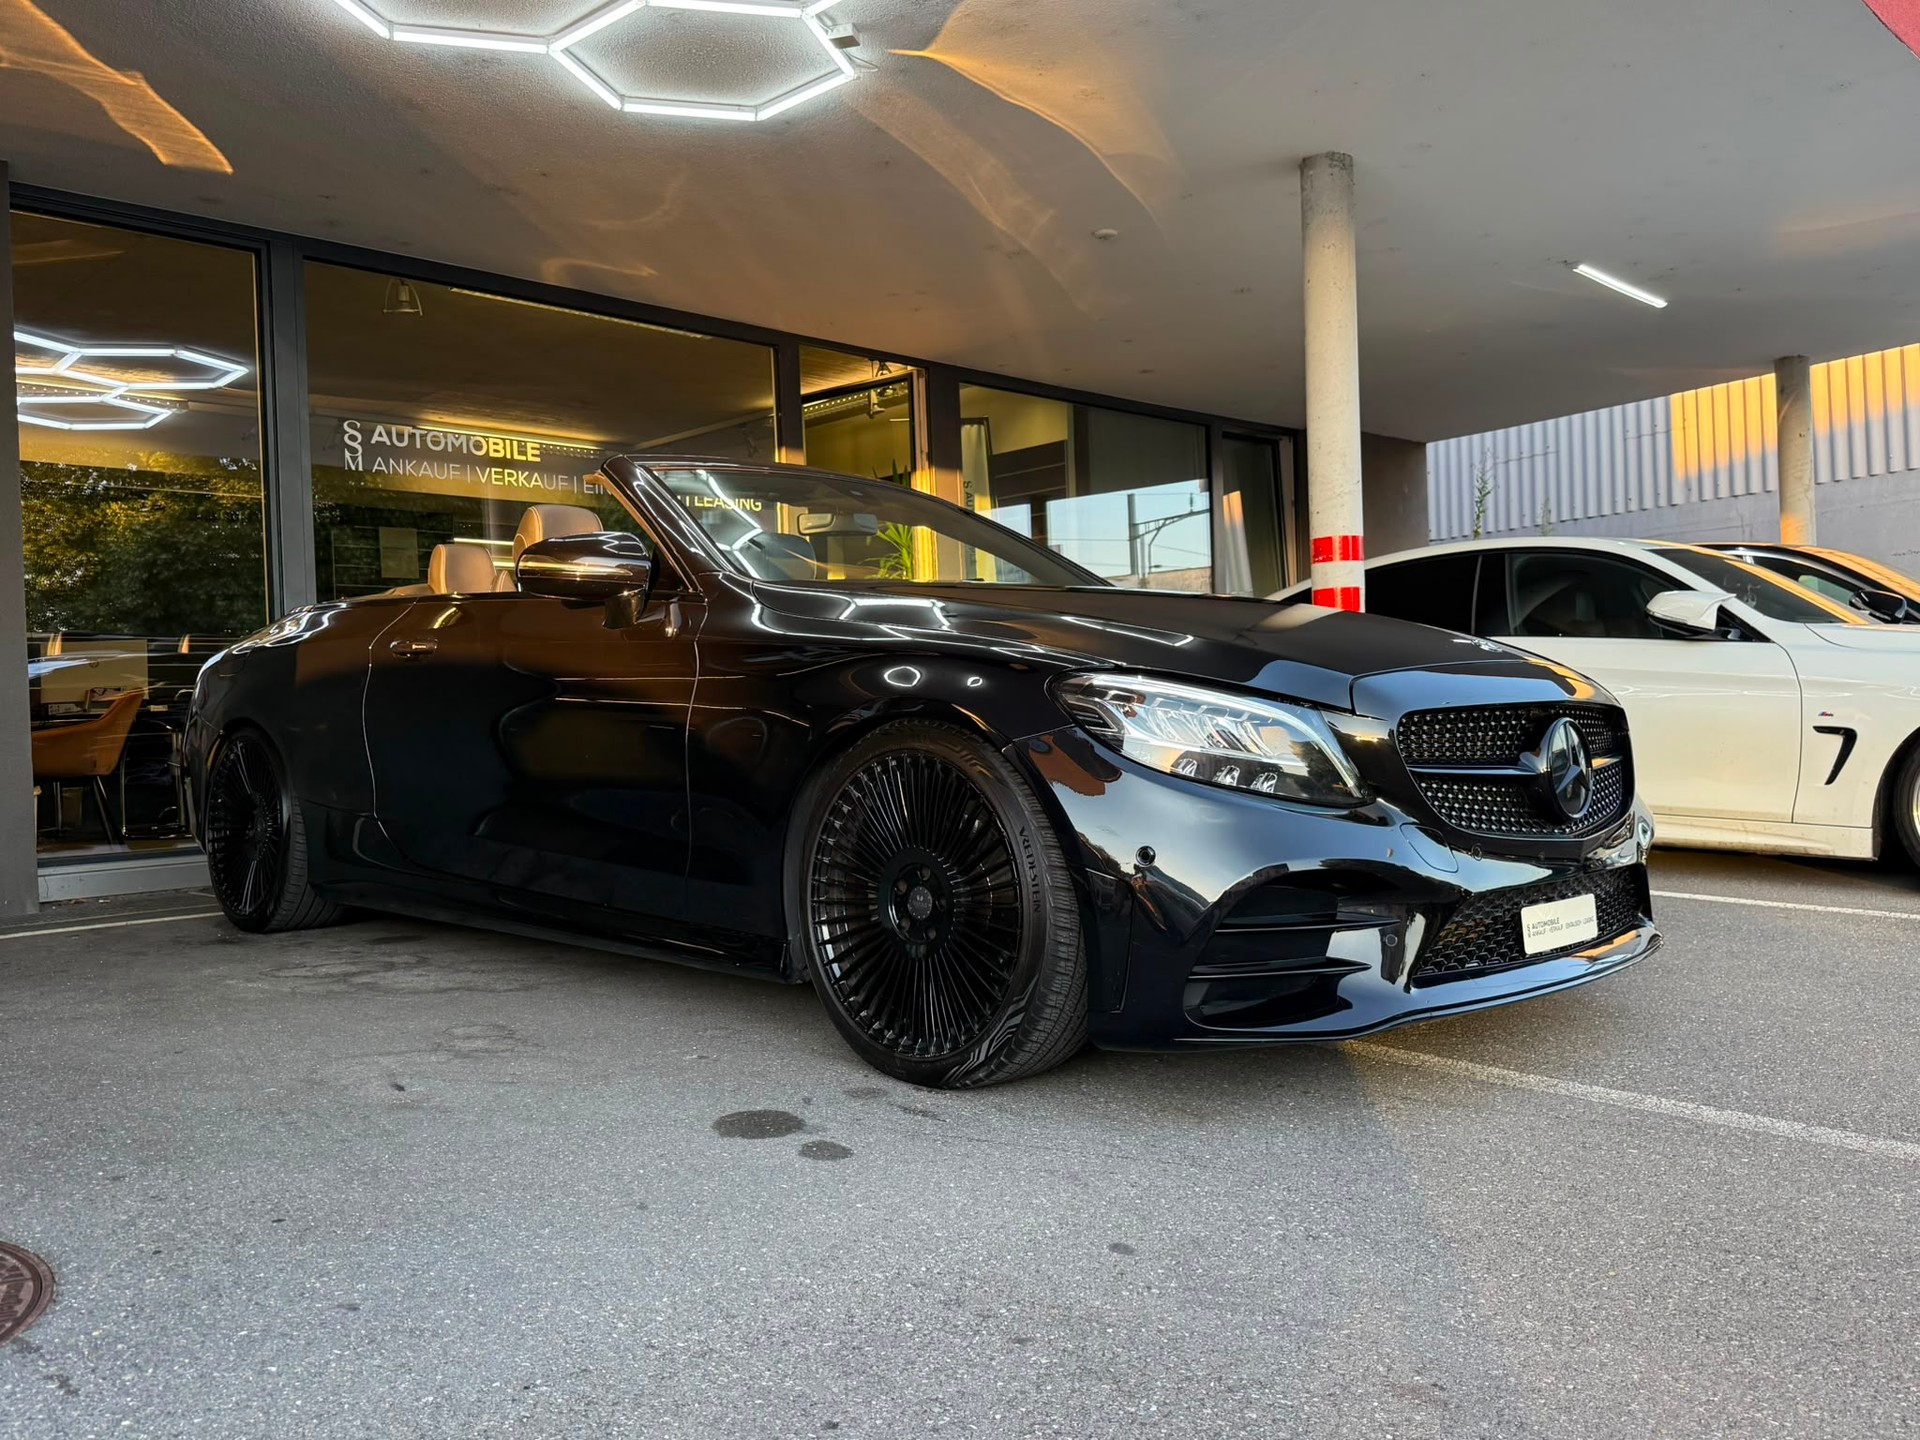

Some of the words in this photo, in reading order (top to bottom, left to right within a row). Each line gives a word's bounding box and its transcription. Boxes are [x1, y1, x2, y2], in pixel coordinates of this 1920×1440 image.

[370, 425, 541, 462] AUTOMOBILE
[372, 457, 461, 480] ANKAUF
[475, 466, 568, 491] VERKAUF
[695, 496, 762, 511] LEASING
[1020, 826, 1041, 913] VREDESTEIN
